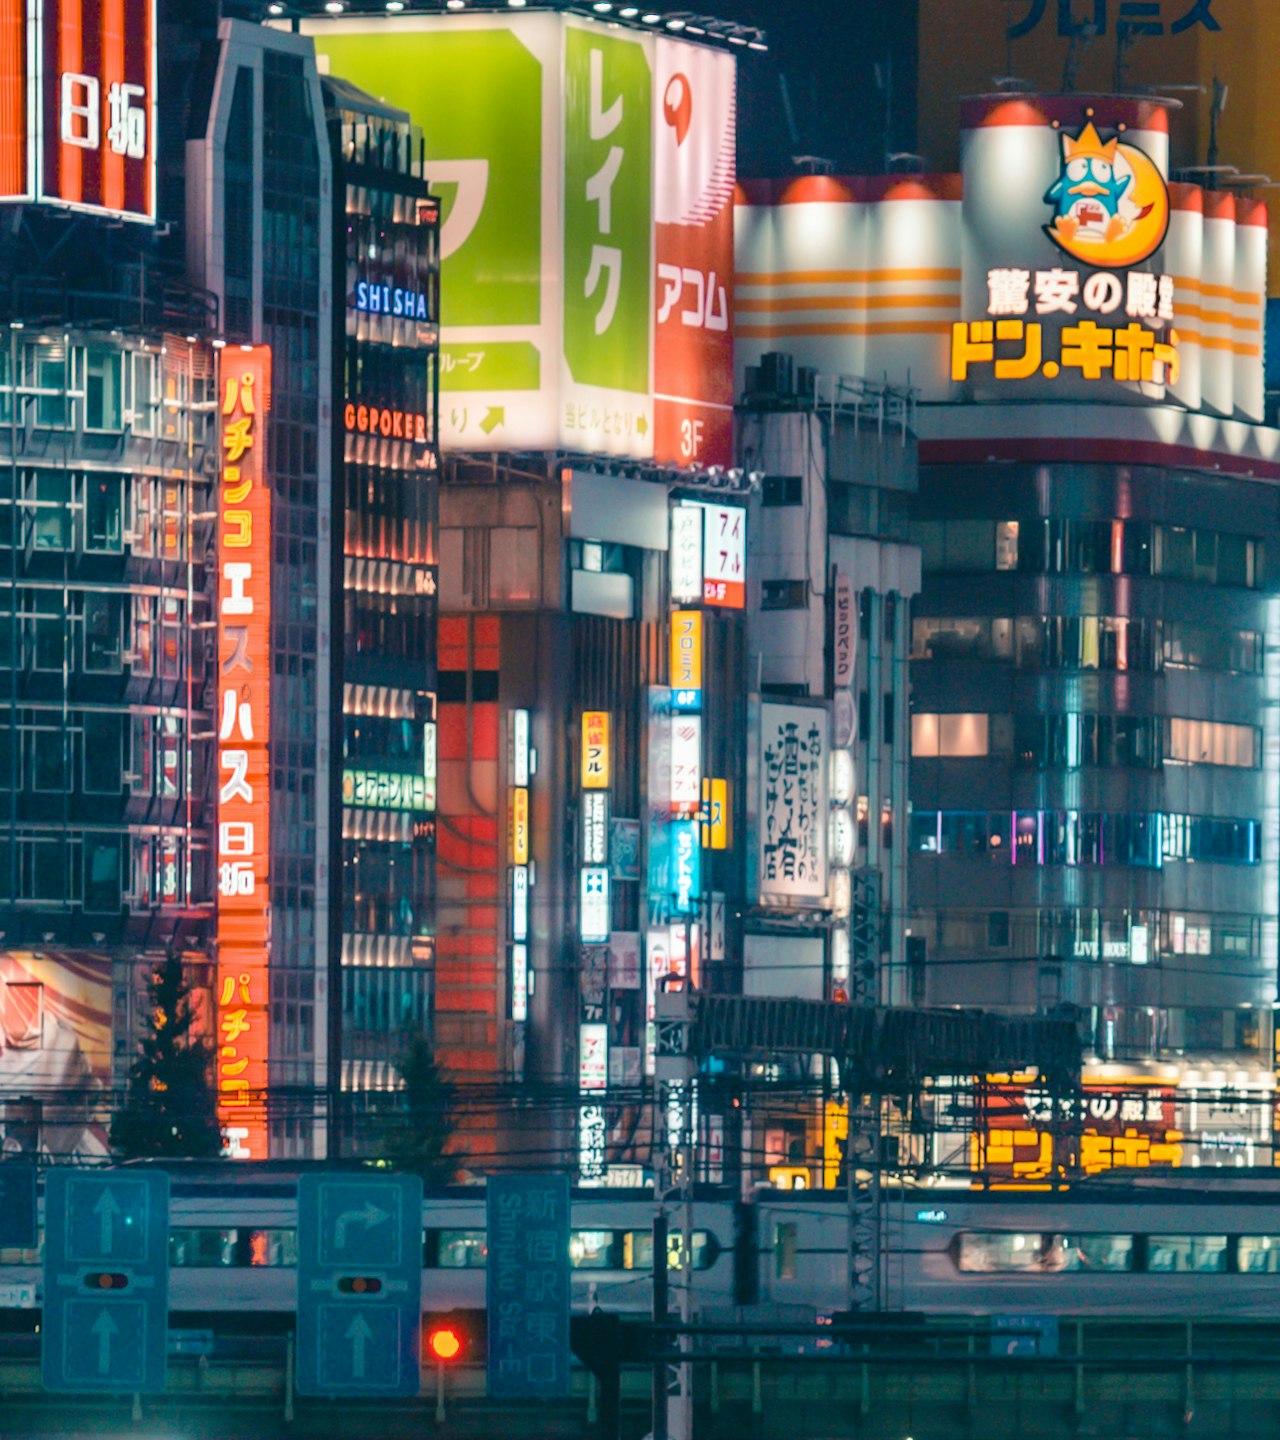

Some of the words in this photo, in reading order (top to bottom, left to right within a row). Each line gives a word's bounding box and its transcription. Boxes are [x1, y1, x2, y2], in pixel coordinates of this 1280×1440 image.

[60, 71, 145, 159] 日拓
[583, 48, 626, 337] レイク
[357, 281, 427, 319] SHISHA
[657, 263, 729, 331] アコム
[987, 268, 1174, 320] 驚安の殿堂
[344, 403, 426, 441] GGPOKER
[681, 418, 704, 457] 3F
[222, 371, 255, 549] パチンコ
[219, 561, 256, 804] エスパス
[680, 621, 694, 681] プロミス
[218, 822, 256, 897] 日拓
[1073, 941, 1100, 957] LIVE
[220, 972, 252, 1108] パチンコ
[584, 1005, 604, 1021] 7F
[497, 1192, 522, 1291] Shinjuku
[526, 1189, 558, 1384] 新宿駅東口
